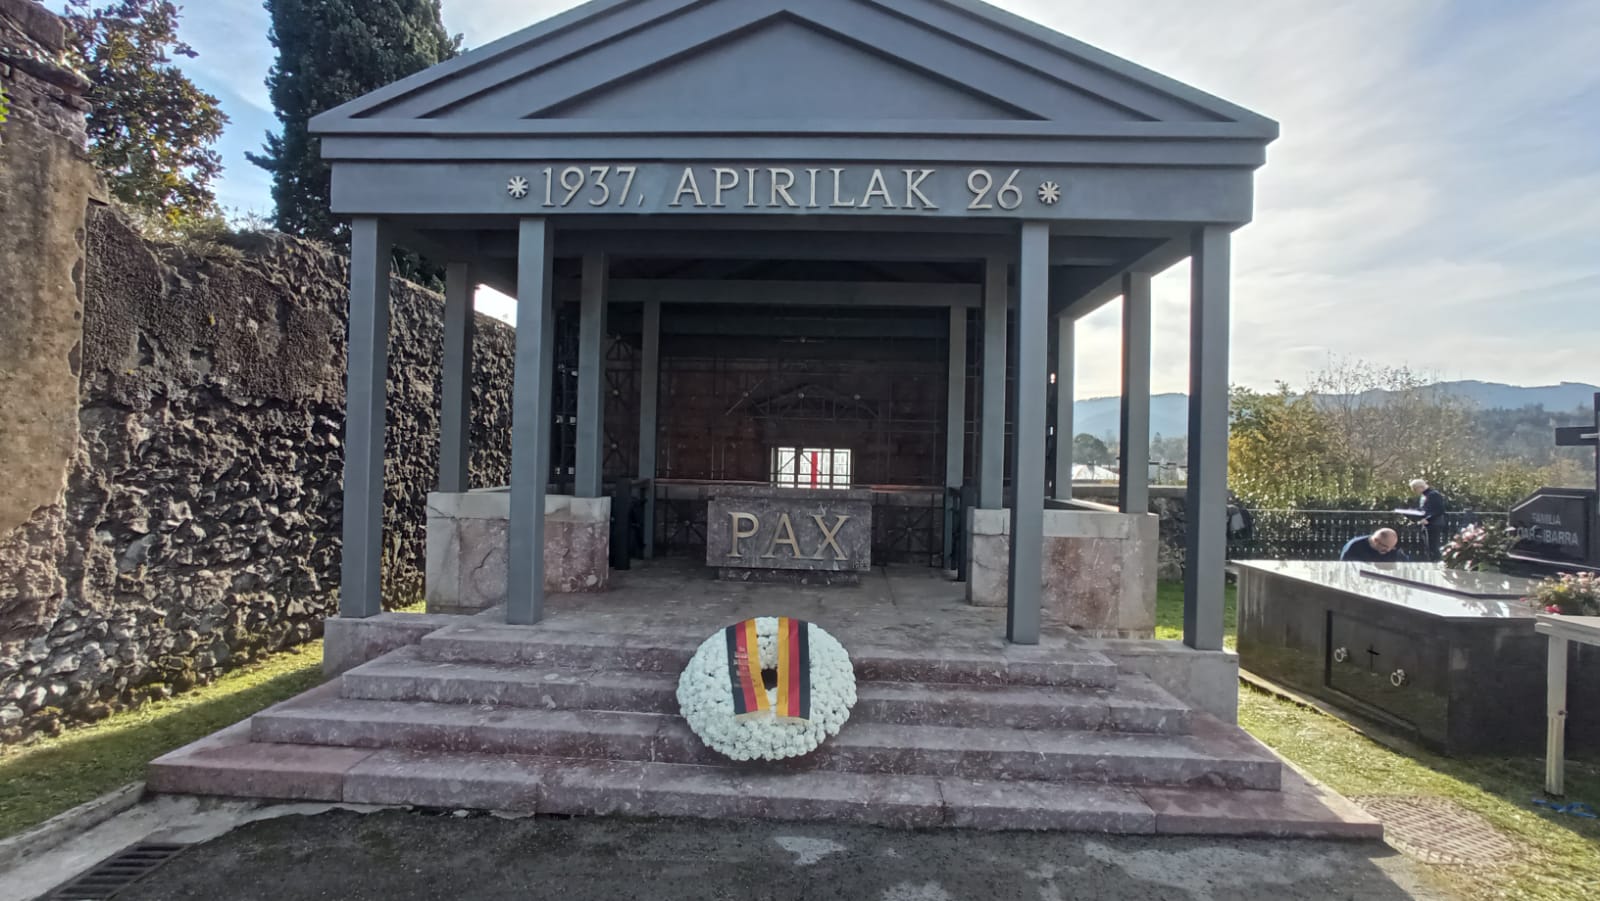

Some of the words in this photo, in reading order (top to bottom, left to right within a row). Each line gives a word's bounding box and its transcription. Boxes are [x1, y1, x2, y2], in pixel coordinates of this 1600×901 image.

[541, 166, 645, 207] 1937,
[668, 167, 939, 210] APIRILAK
[967, 169, 1023, 210] 26
[726, 511, 851, 561] PAX
[1532, 513, 1561, 525] FAMILIA
